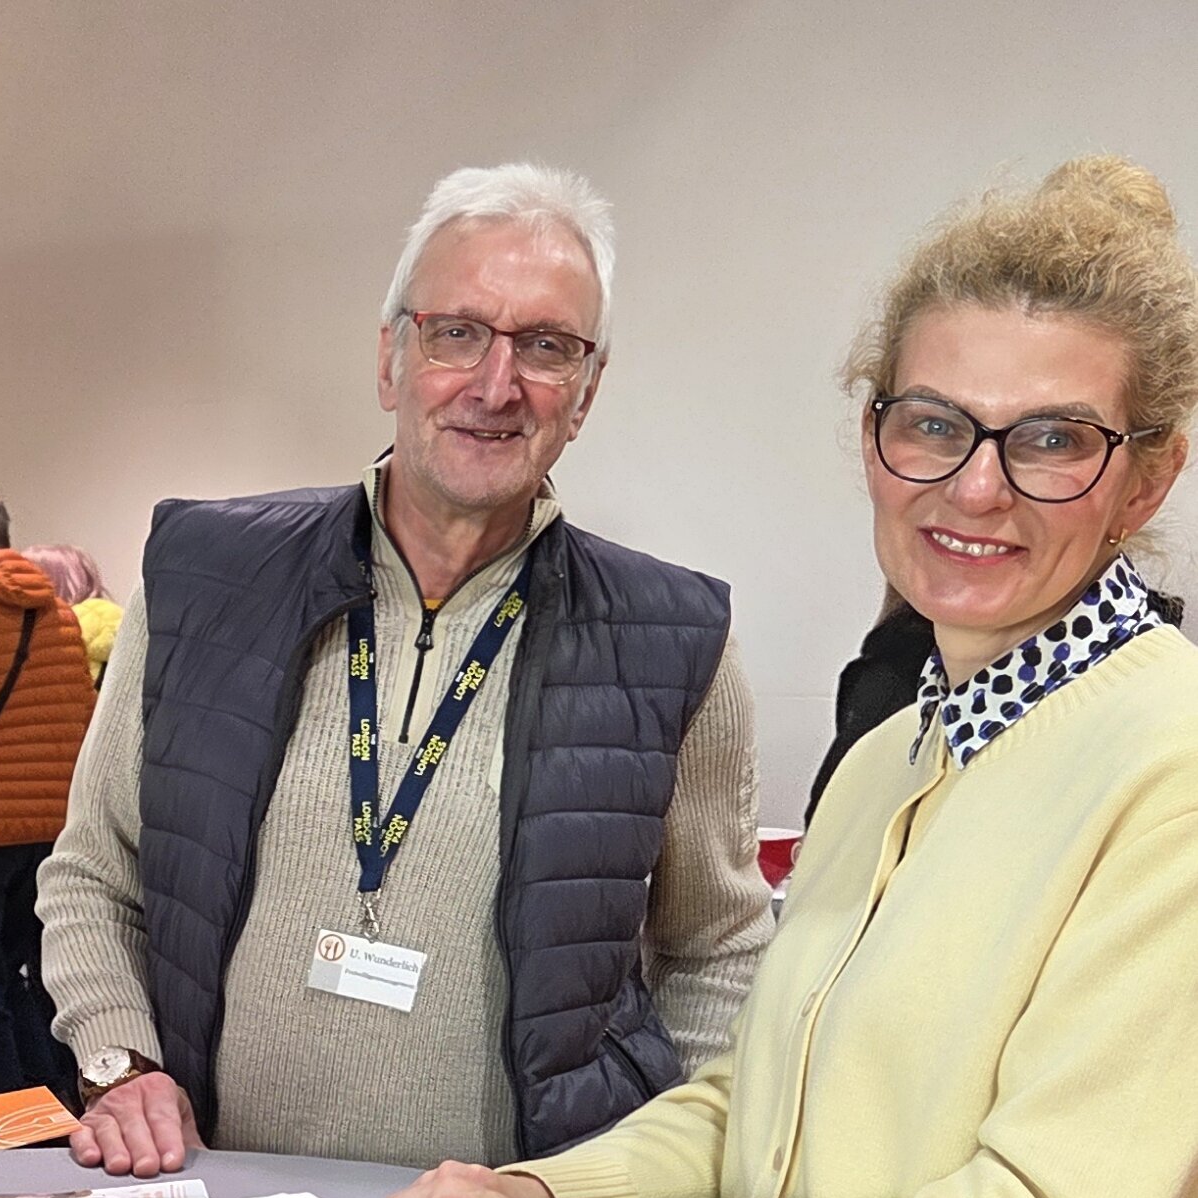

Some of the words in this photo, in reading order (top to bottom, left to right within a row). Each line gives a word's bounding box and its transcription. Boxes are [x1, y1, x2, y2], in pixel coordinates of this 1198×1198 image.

[350, 653, 359, 677] PASS
[358, 638, 368, 680] LONDON
[453, 659, 481, 702] LONDON
[469, 667, 486, 690] PASS
[351, 733, 361, 757] PASS
[361, 718, 370, 761] LONDON
[414, 734, 441, 776] LONDON
[429, 741, 448, 766] PASS
[353, 816, 363, 843] PASS
[392, 819, 409, 844] PASS
[349, 948, 362, 960] U.
[364, 951, 419, 974] Wunderlich
